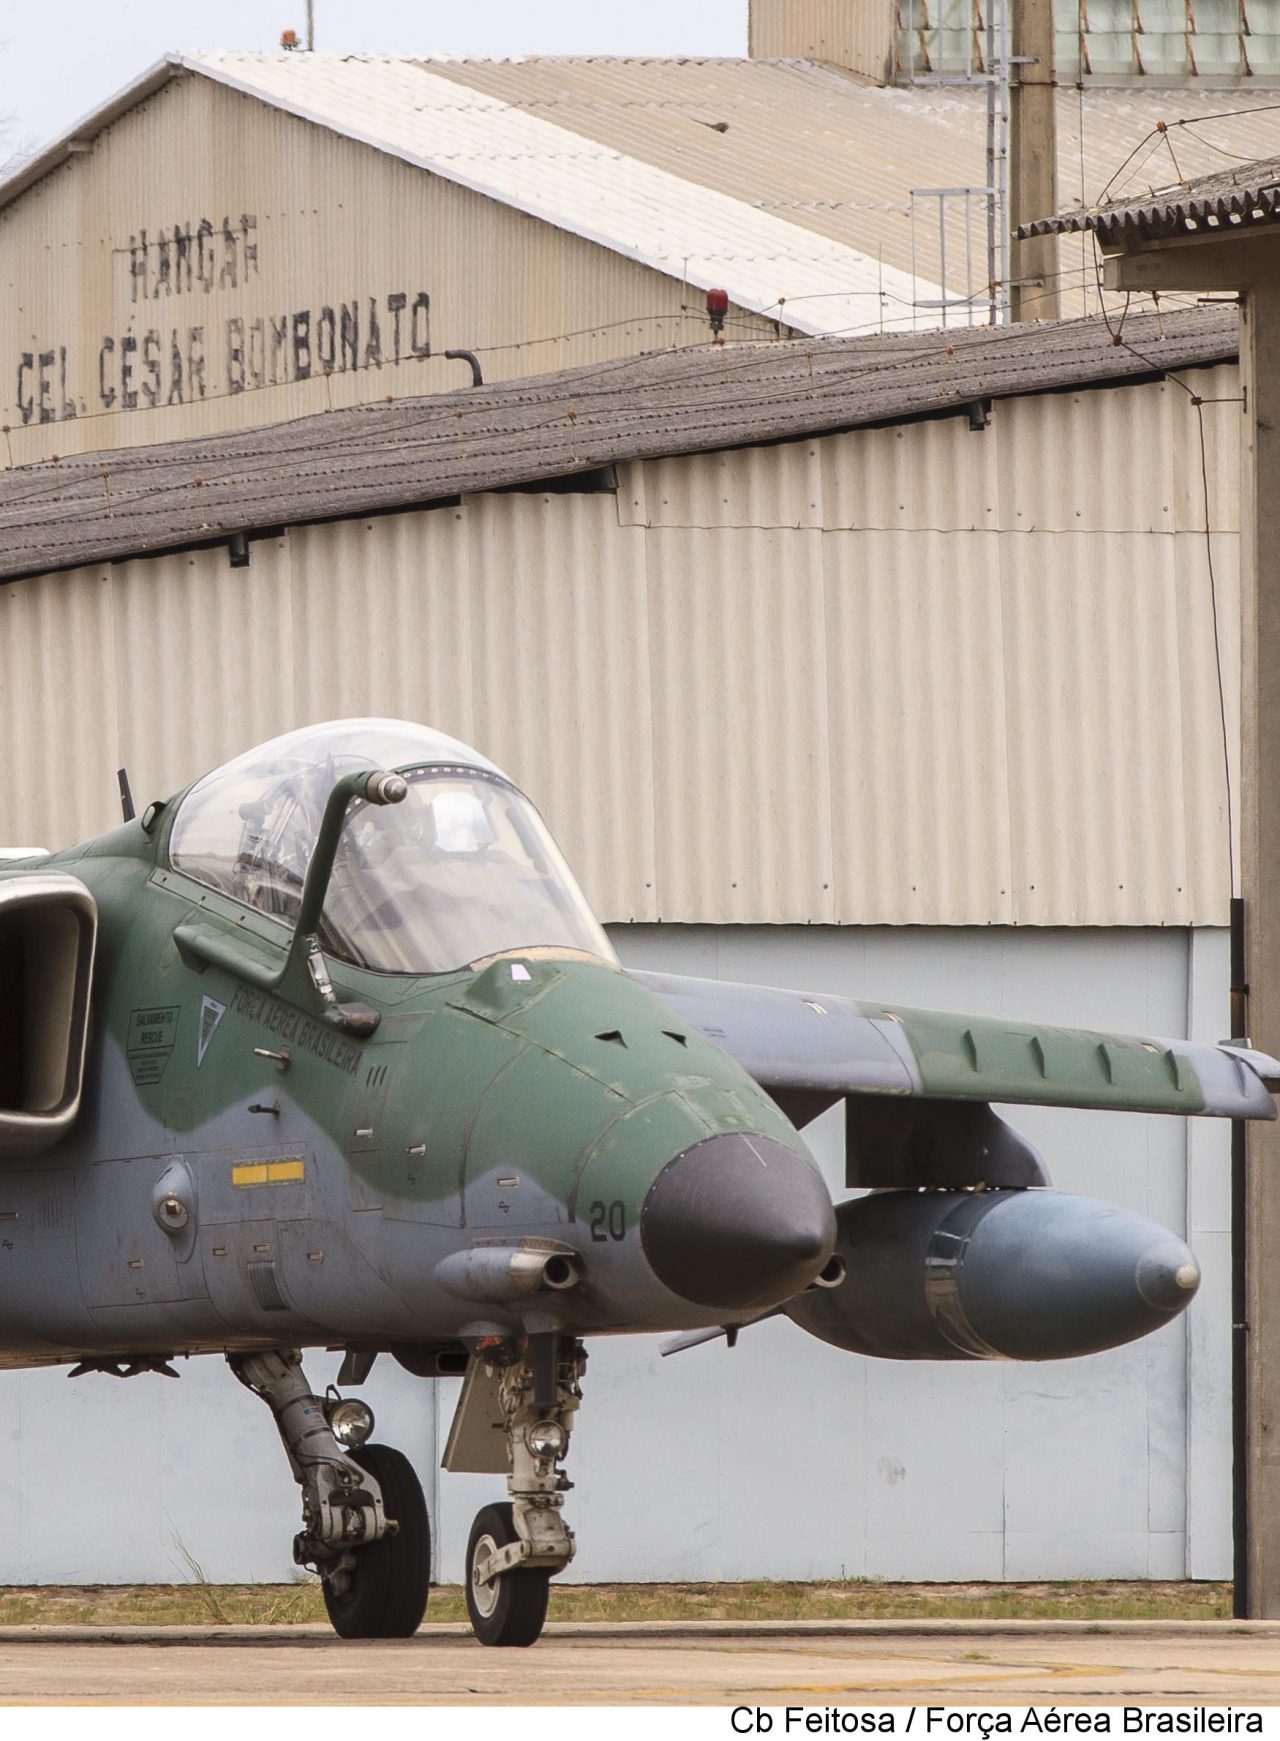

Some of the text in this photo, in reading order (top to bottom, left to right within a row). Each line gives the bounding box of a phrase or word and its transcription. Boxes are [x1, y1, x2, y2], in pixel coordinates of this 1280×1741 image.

[128, 213, 260, 303] HANGAR
[227, 292, 431, 395] BOMBONATO
[140, 1031, 163, 1045] RESCUE
[590, 1200, 626, 1242] 20
